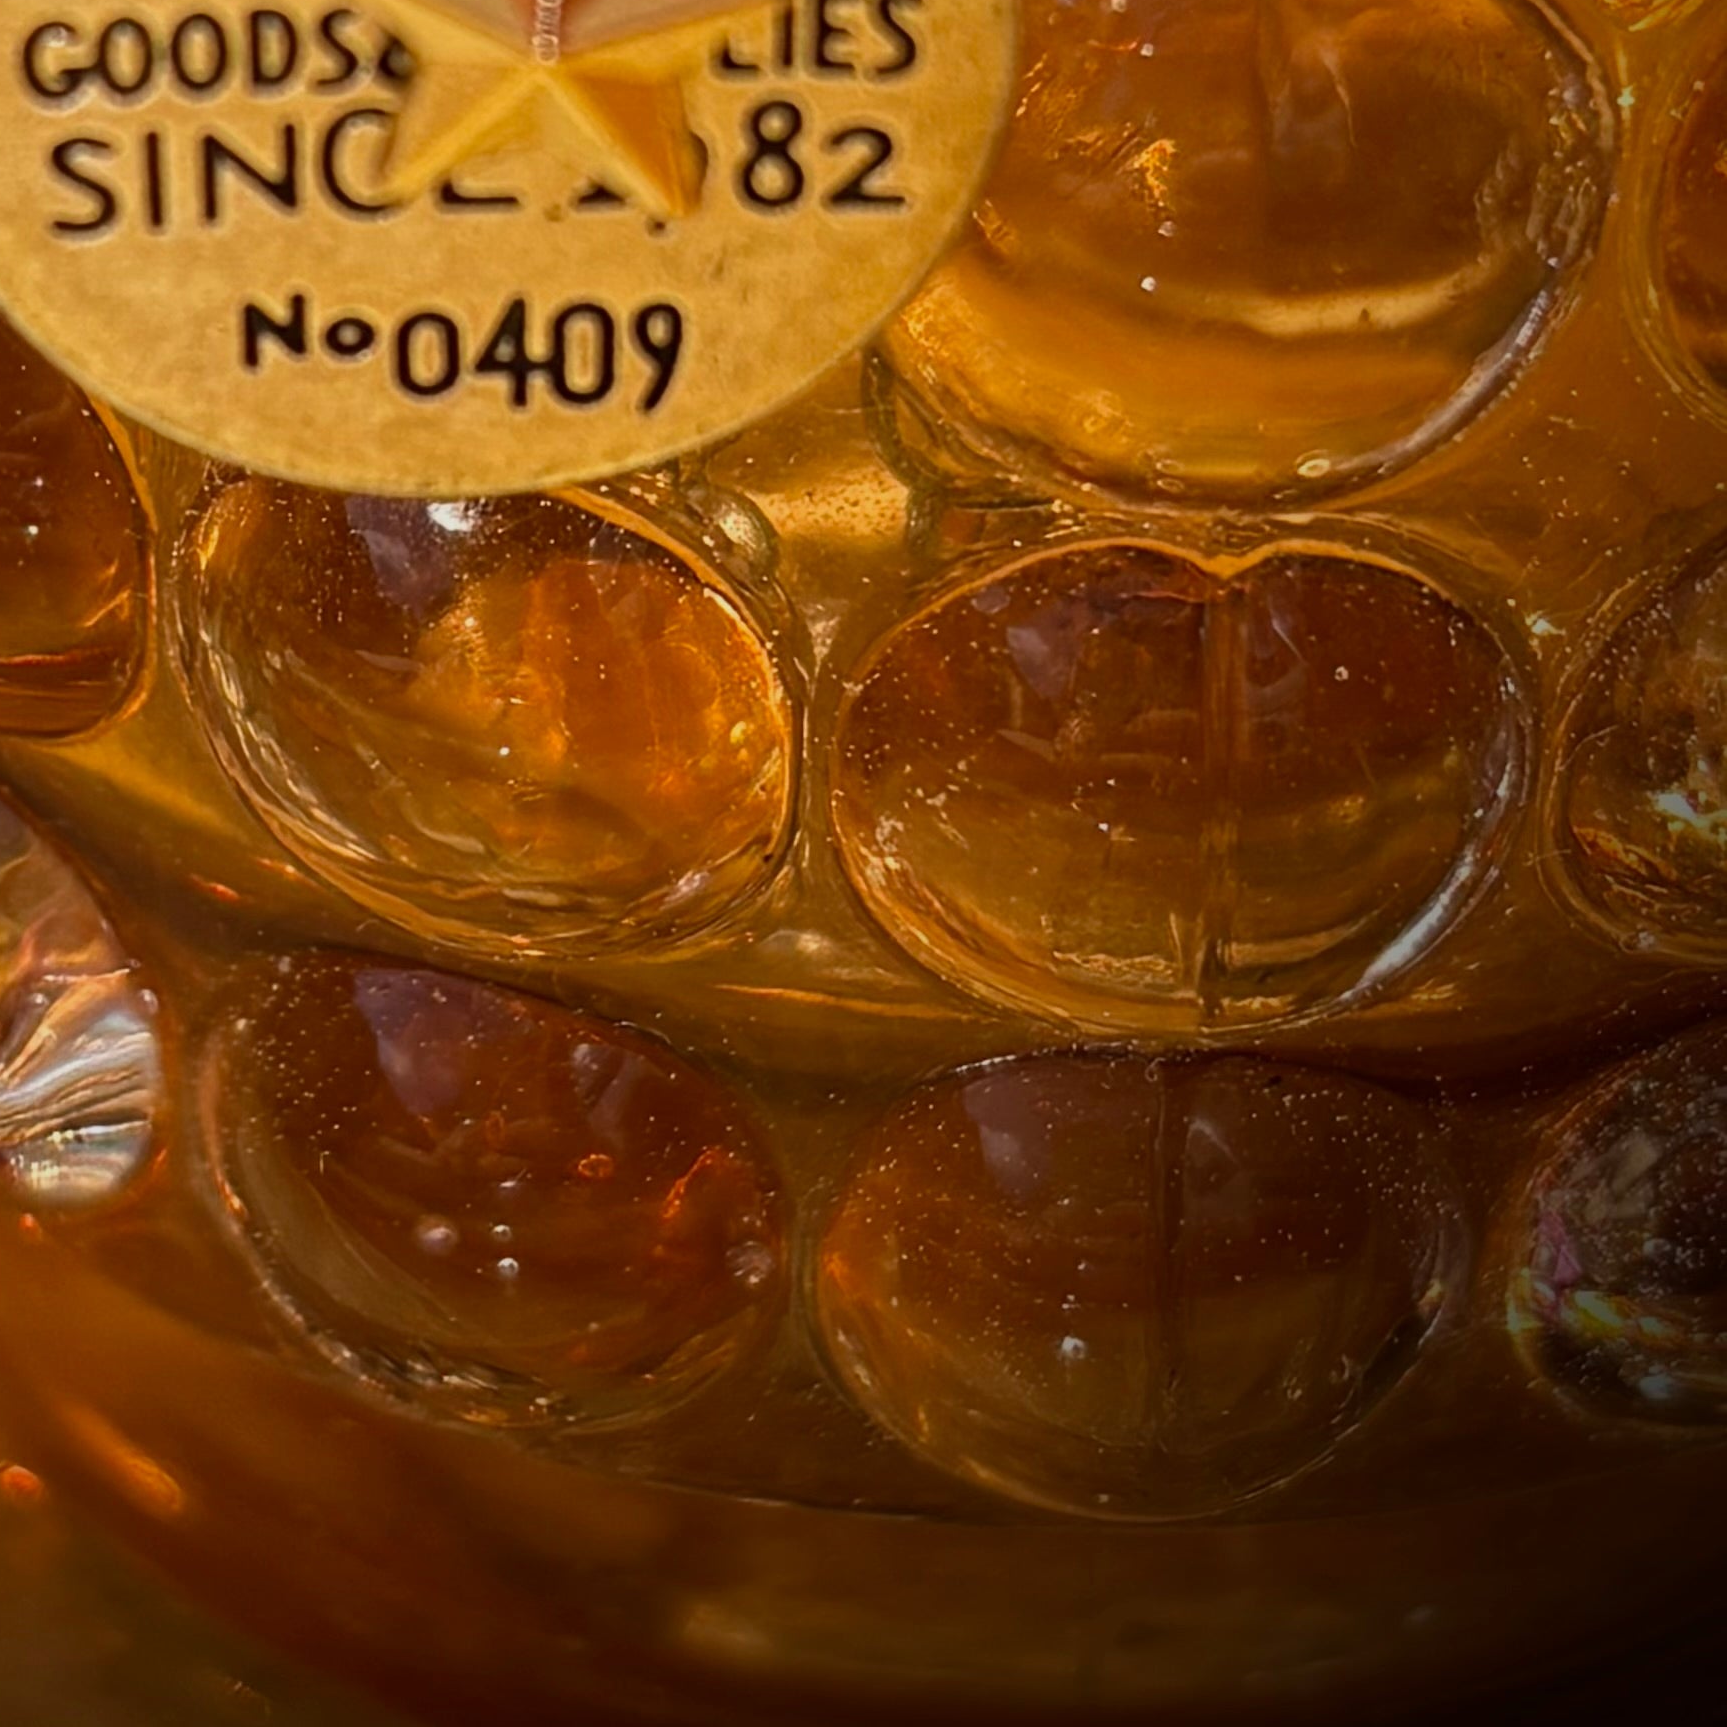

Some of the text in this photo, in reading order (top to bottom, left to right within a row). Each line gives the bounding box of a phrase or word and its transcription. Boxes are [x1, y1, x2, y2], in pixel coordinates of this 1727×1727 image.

[21, 8, 361, 100] GOODS
[50, 99, 907, 233] SINC 82
[396, 297, 684, 413] 0409
